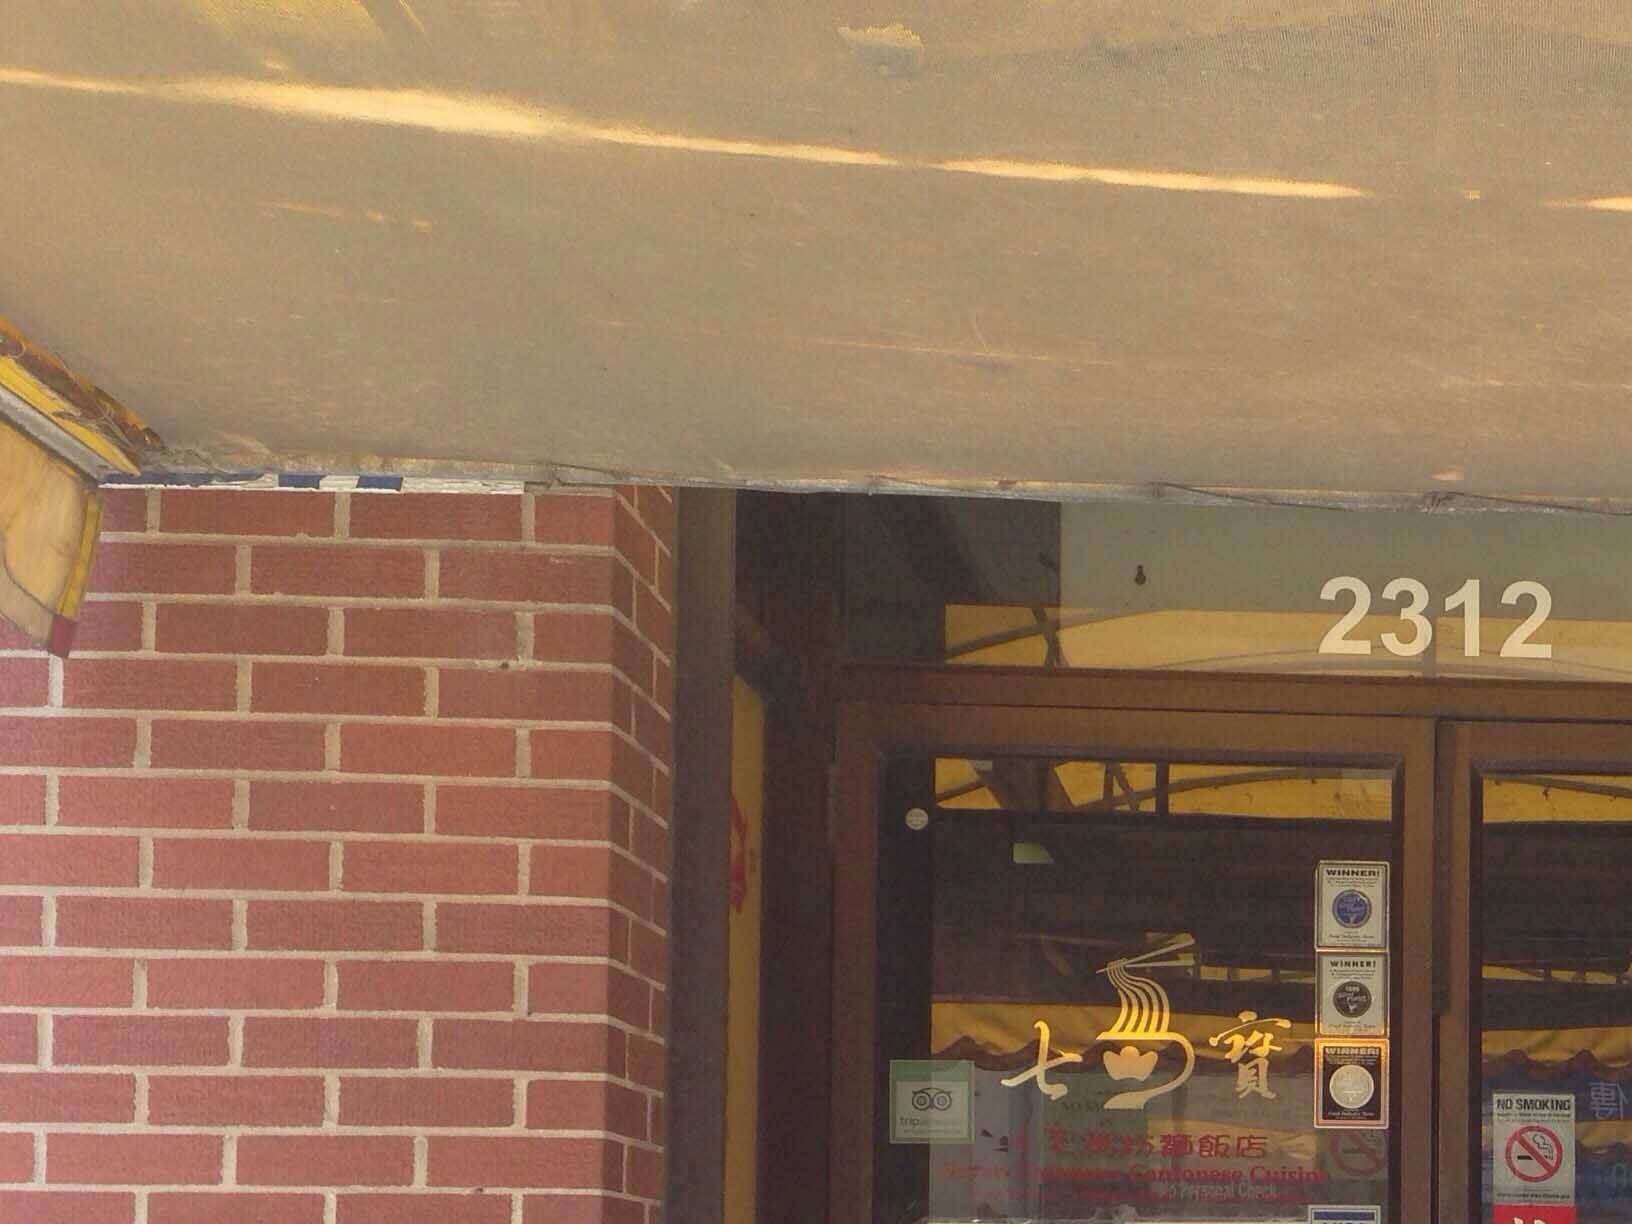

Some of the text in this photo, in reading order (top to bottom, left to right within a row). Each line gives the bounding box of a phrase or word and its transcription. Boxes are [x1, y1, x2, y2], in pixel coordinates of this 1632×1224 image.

[1318, 576, 1552, 659] 2312
[1497, 1098, 1571, 1111] NO SMOKING
